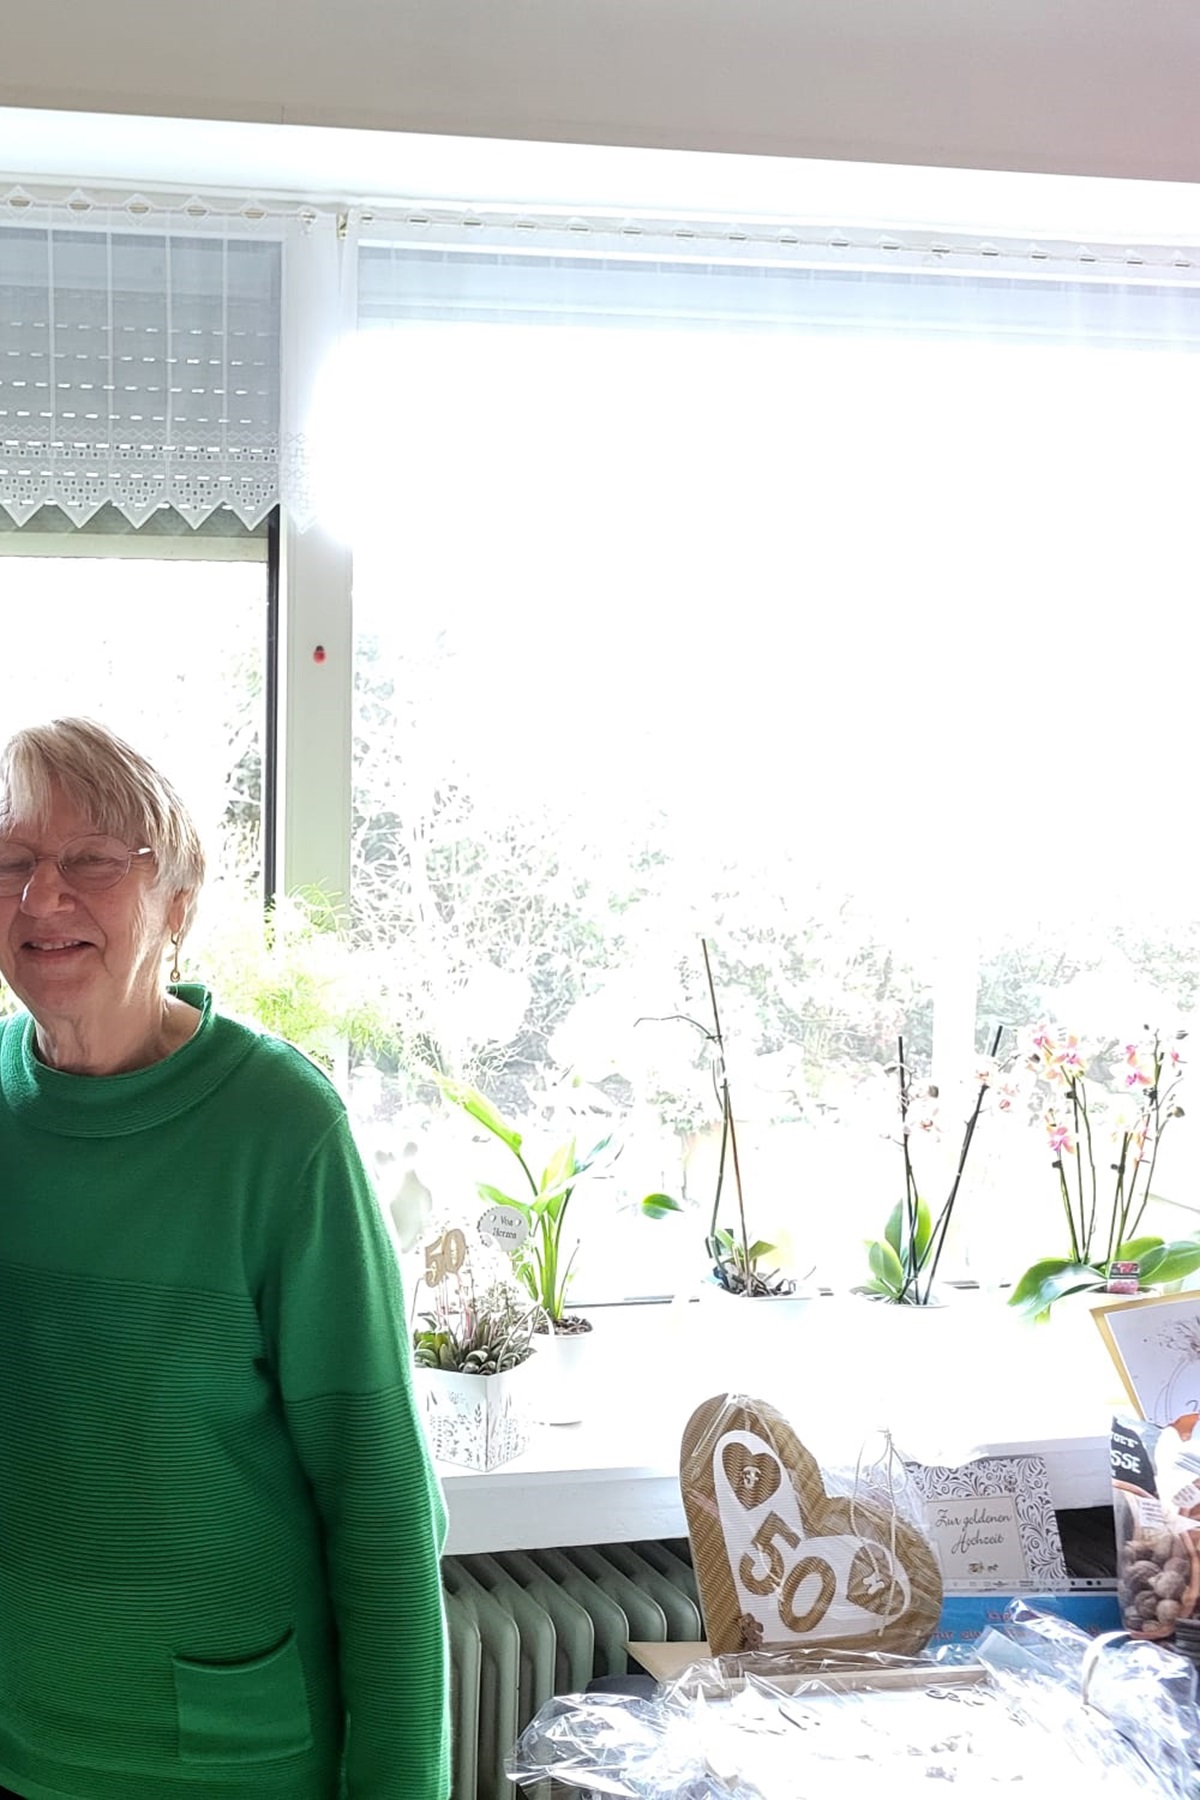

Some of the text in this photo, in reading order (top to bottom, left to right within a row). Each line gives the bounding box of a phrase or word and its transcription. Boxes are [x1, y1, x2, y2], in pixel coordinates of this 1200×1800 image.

[492, 1227, 518, 1240] Herzen
[500, 1215, 514, 1227] Von
[424, 1228, 467, 1288] 50
[935, 1507, 1013, 1531] Zur goldenen
[951, 1527, 1005, 1555] Hochzeit
[738, 1510, 837, 1634] 50
